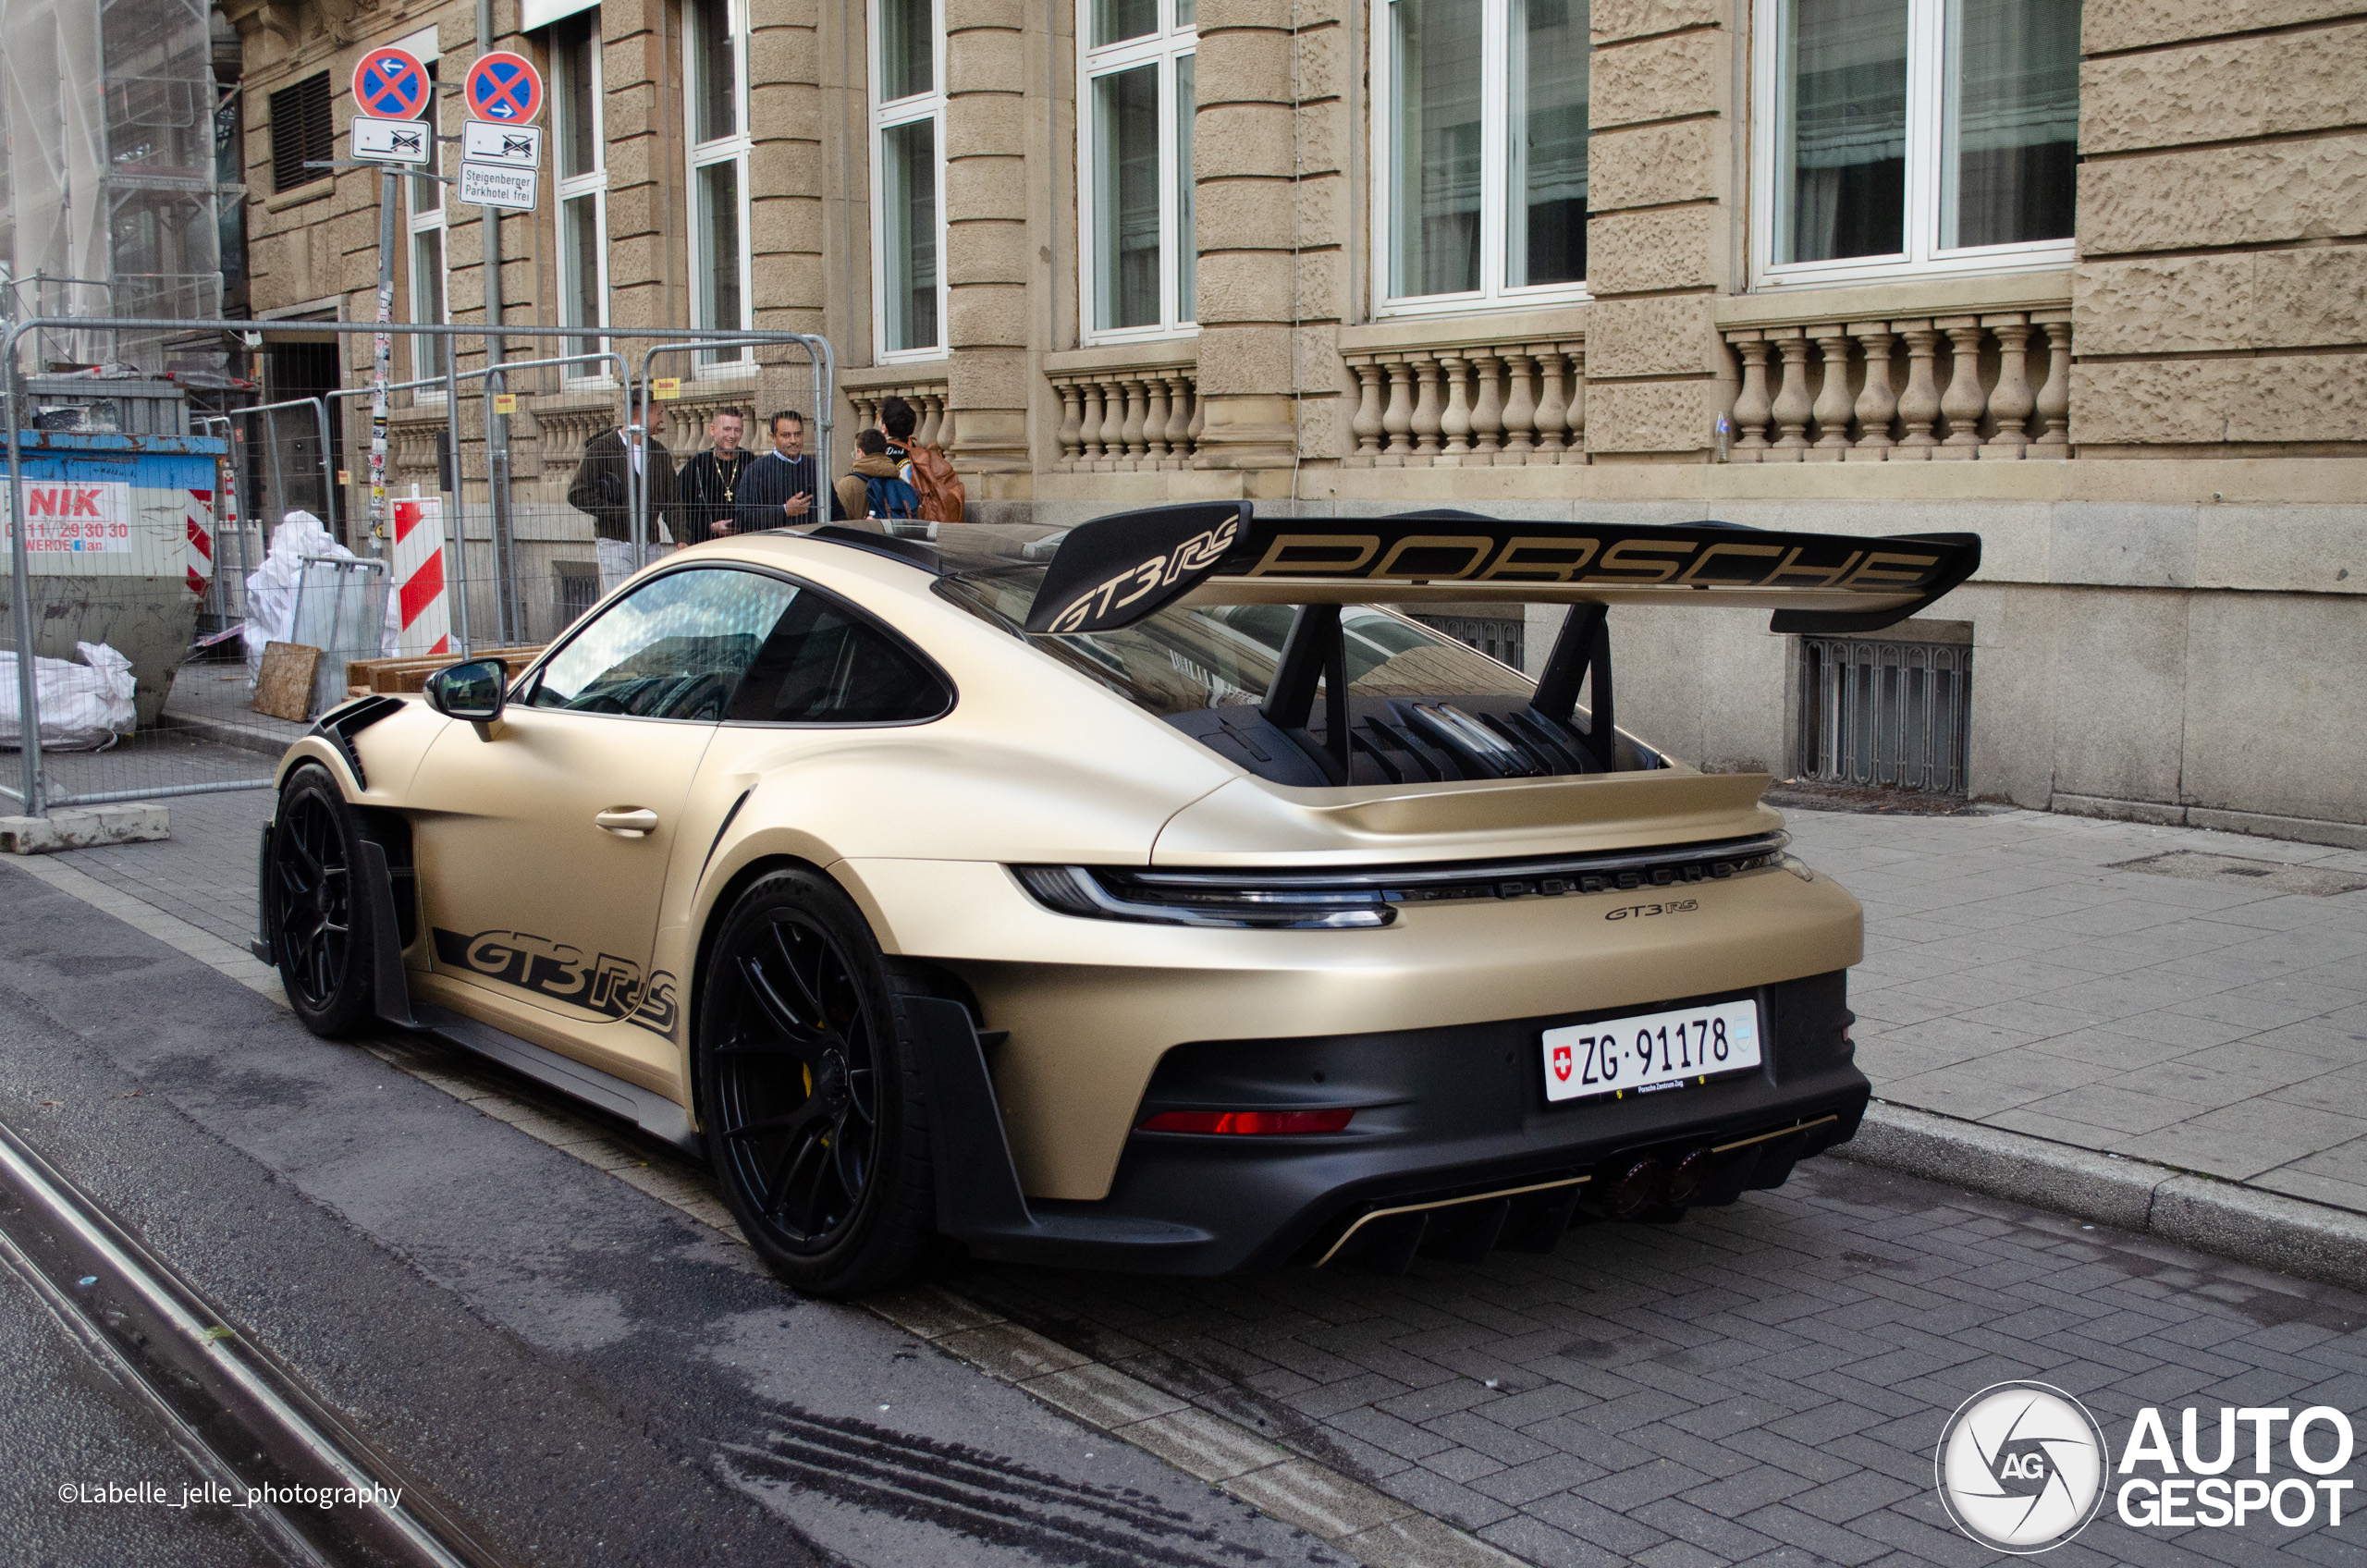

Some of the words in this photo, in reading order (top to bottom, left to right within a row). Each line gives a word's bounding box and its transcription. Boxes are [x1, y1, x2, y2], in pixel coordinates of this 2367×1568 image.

[466, 169, 531, 190] Steigenberger
[465, 184, 509, 200] Parkhotel
[514, 190, 530, 202] frei
[29, 488, 104, 517] NIK
[6, 522, 45, 537] 011
[1245, 533, 1940, 587] PORSCHE
[1637, 1084, 1656, 1093] Porsche
